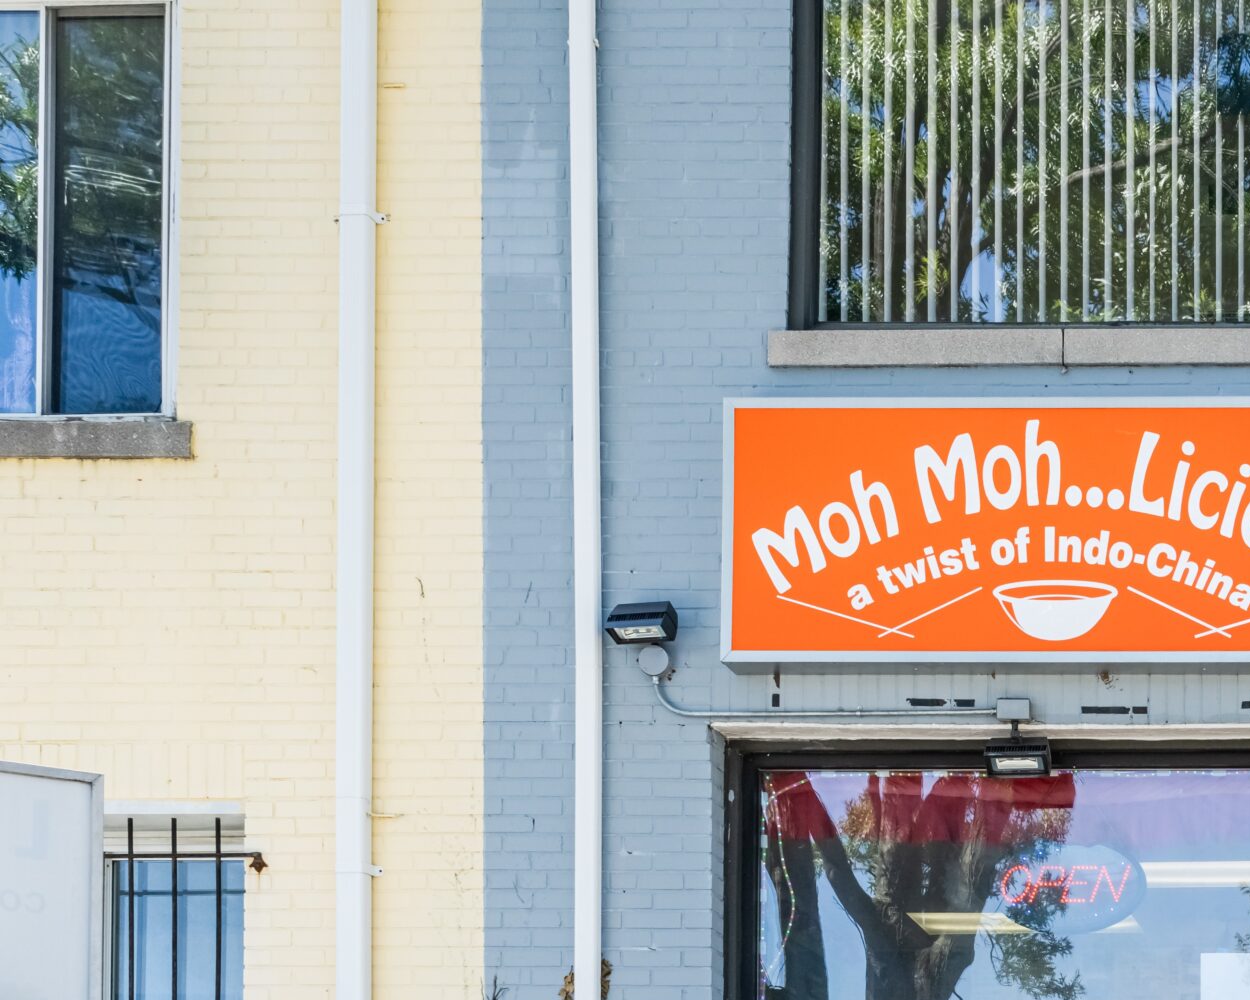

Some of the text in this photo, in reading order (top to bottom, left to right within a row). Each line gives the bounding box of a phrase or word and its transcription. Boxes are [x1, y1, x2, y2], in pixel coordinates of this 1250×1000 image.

[751, 469, 900, 594] Moh
[847, 583, 874, 611] a
[877, 537, 980, 595] twist
[990, 526, 1031, 566] of
[1001, 863, 1132, 904] OPEN
